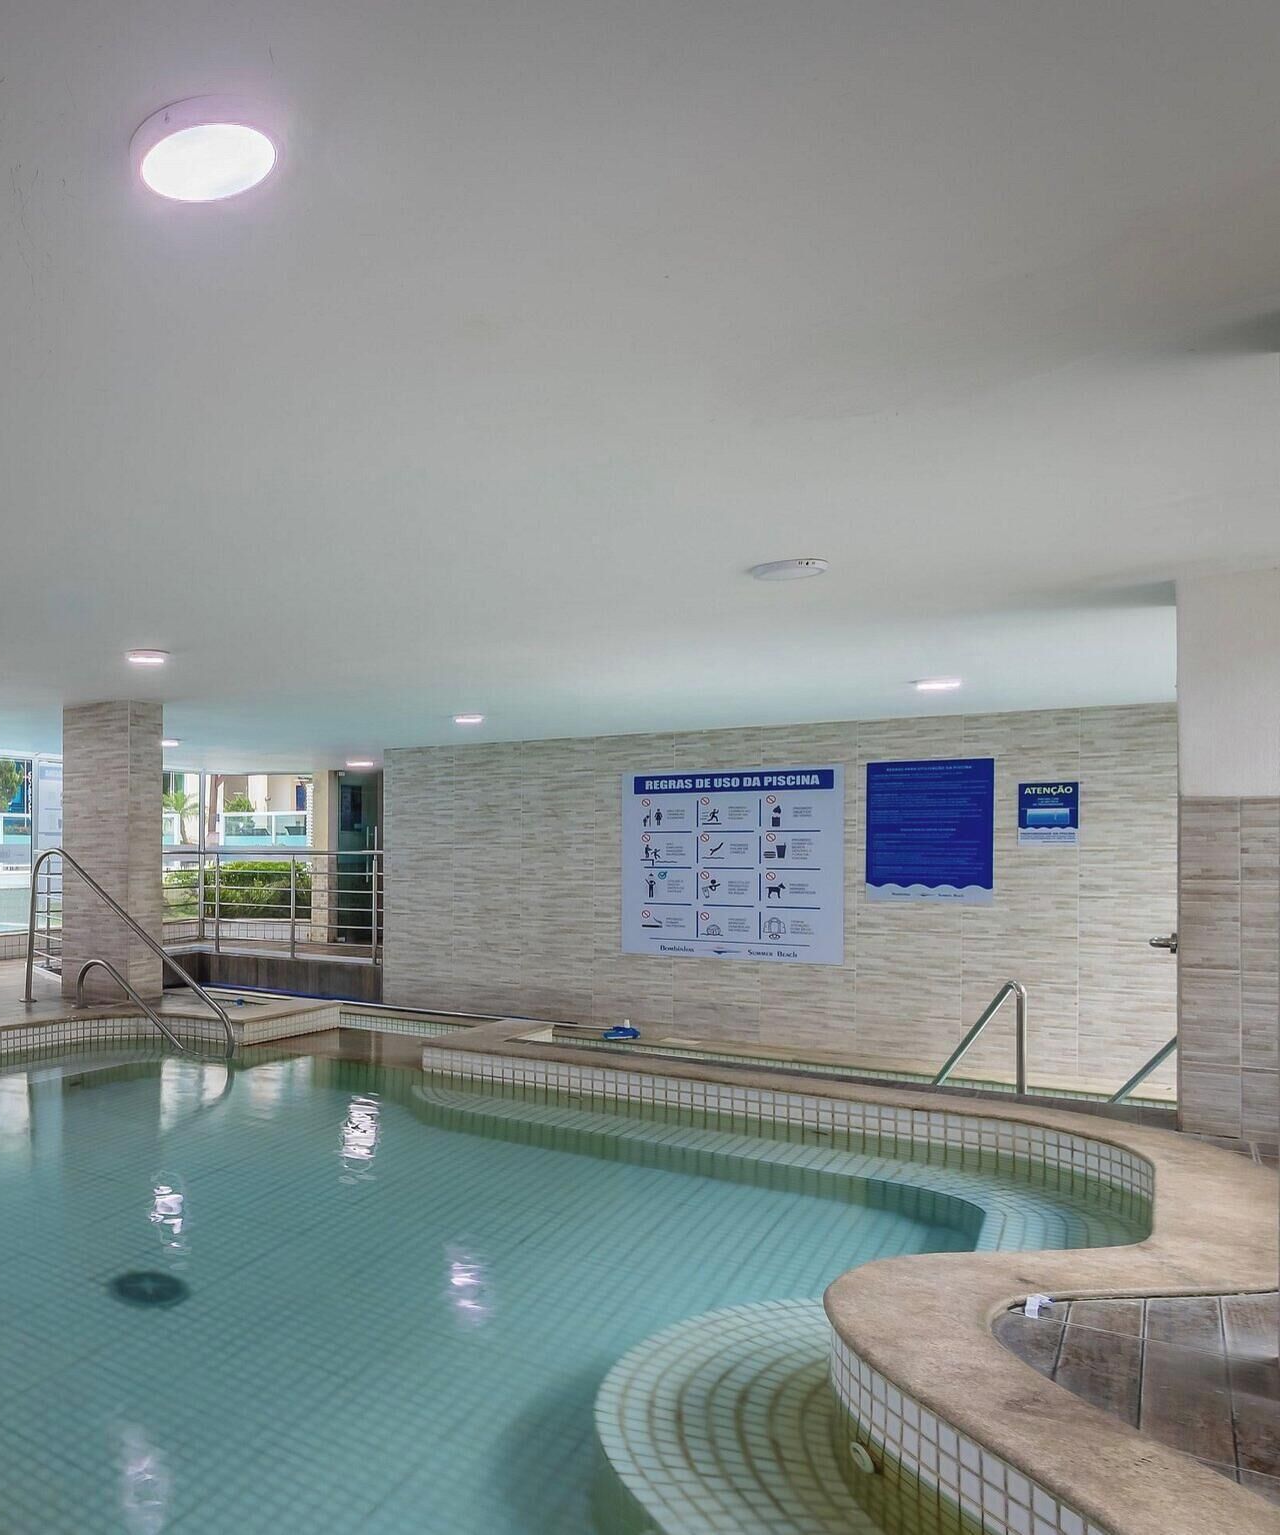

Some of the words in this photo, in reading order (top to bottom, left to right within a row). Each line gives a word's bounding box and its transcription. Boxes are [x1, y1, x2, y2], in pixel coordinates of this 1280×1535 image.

[645, 779, 693, 790] REGRAS
[695, 778, 711, 789] DE
[714, 776, 740, 788] USO
[743, 776, 761, 787] DA
[764, 774, 821, 786] PISCINA
[1024, 785, 1073, 796] ATENÇÃO
